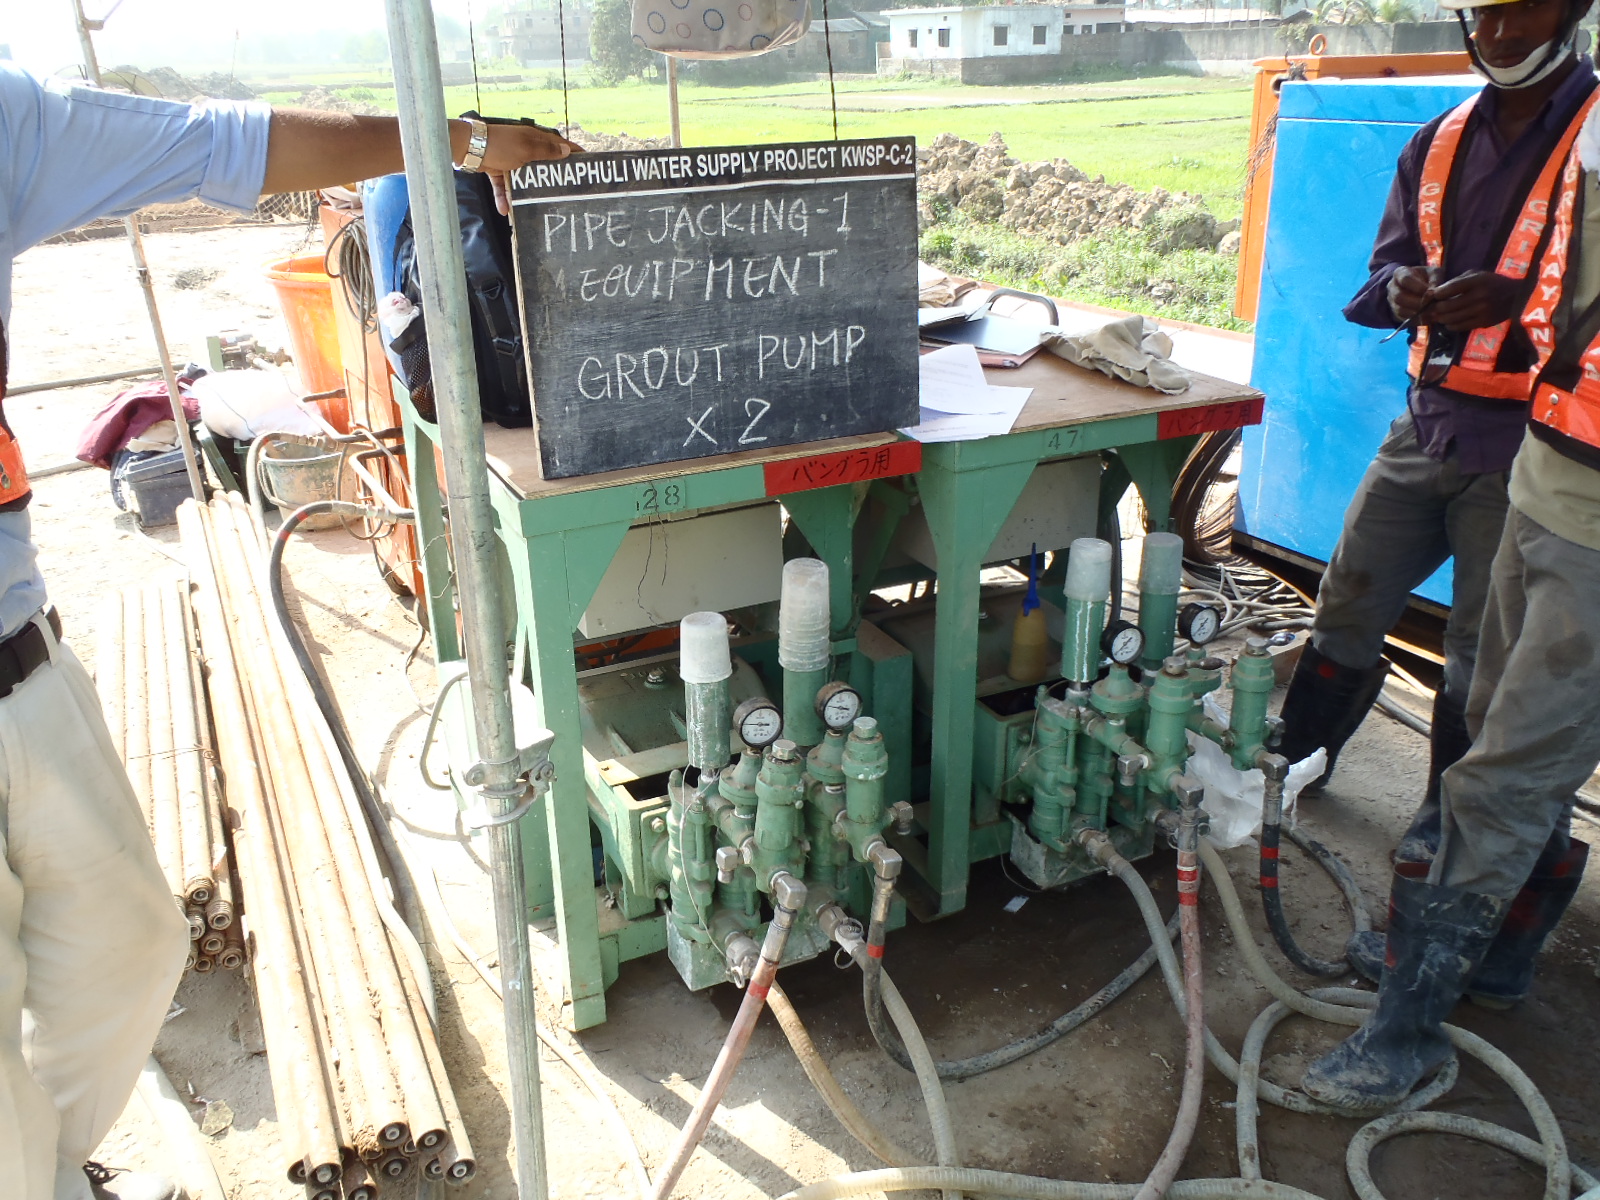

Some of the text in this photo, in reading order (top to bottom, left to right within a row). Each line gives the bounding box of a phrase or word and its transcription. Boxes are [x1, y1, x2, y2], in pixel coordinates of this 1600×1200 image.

[511, 144, 914, 190] KARNAPHULI WATER SUPPLY PROJECT KWSP-C-2
[544, 192, 851, 252] PIPE JACKING-1
[577, 343, 730, 400] GROUT
[758, 325, 866, 379] PUMP
[1048, 429, 1079, 451] 47
[793, 448, 891, 483] バングラ用
[643, 484, 680, 511] 28
